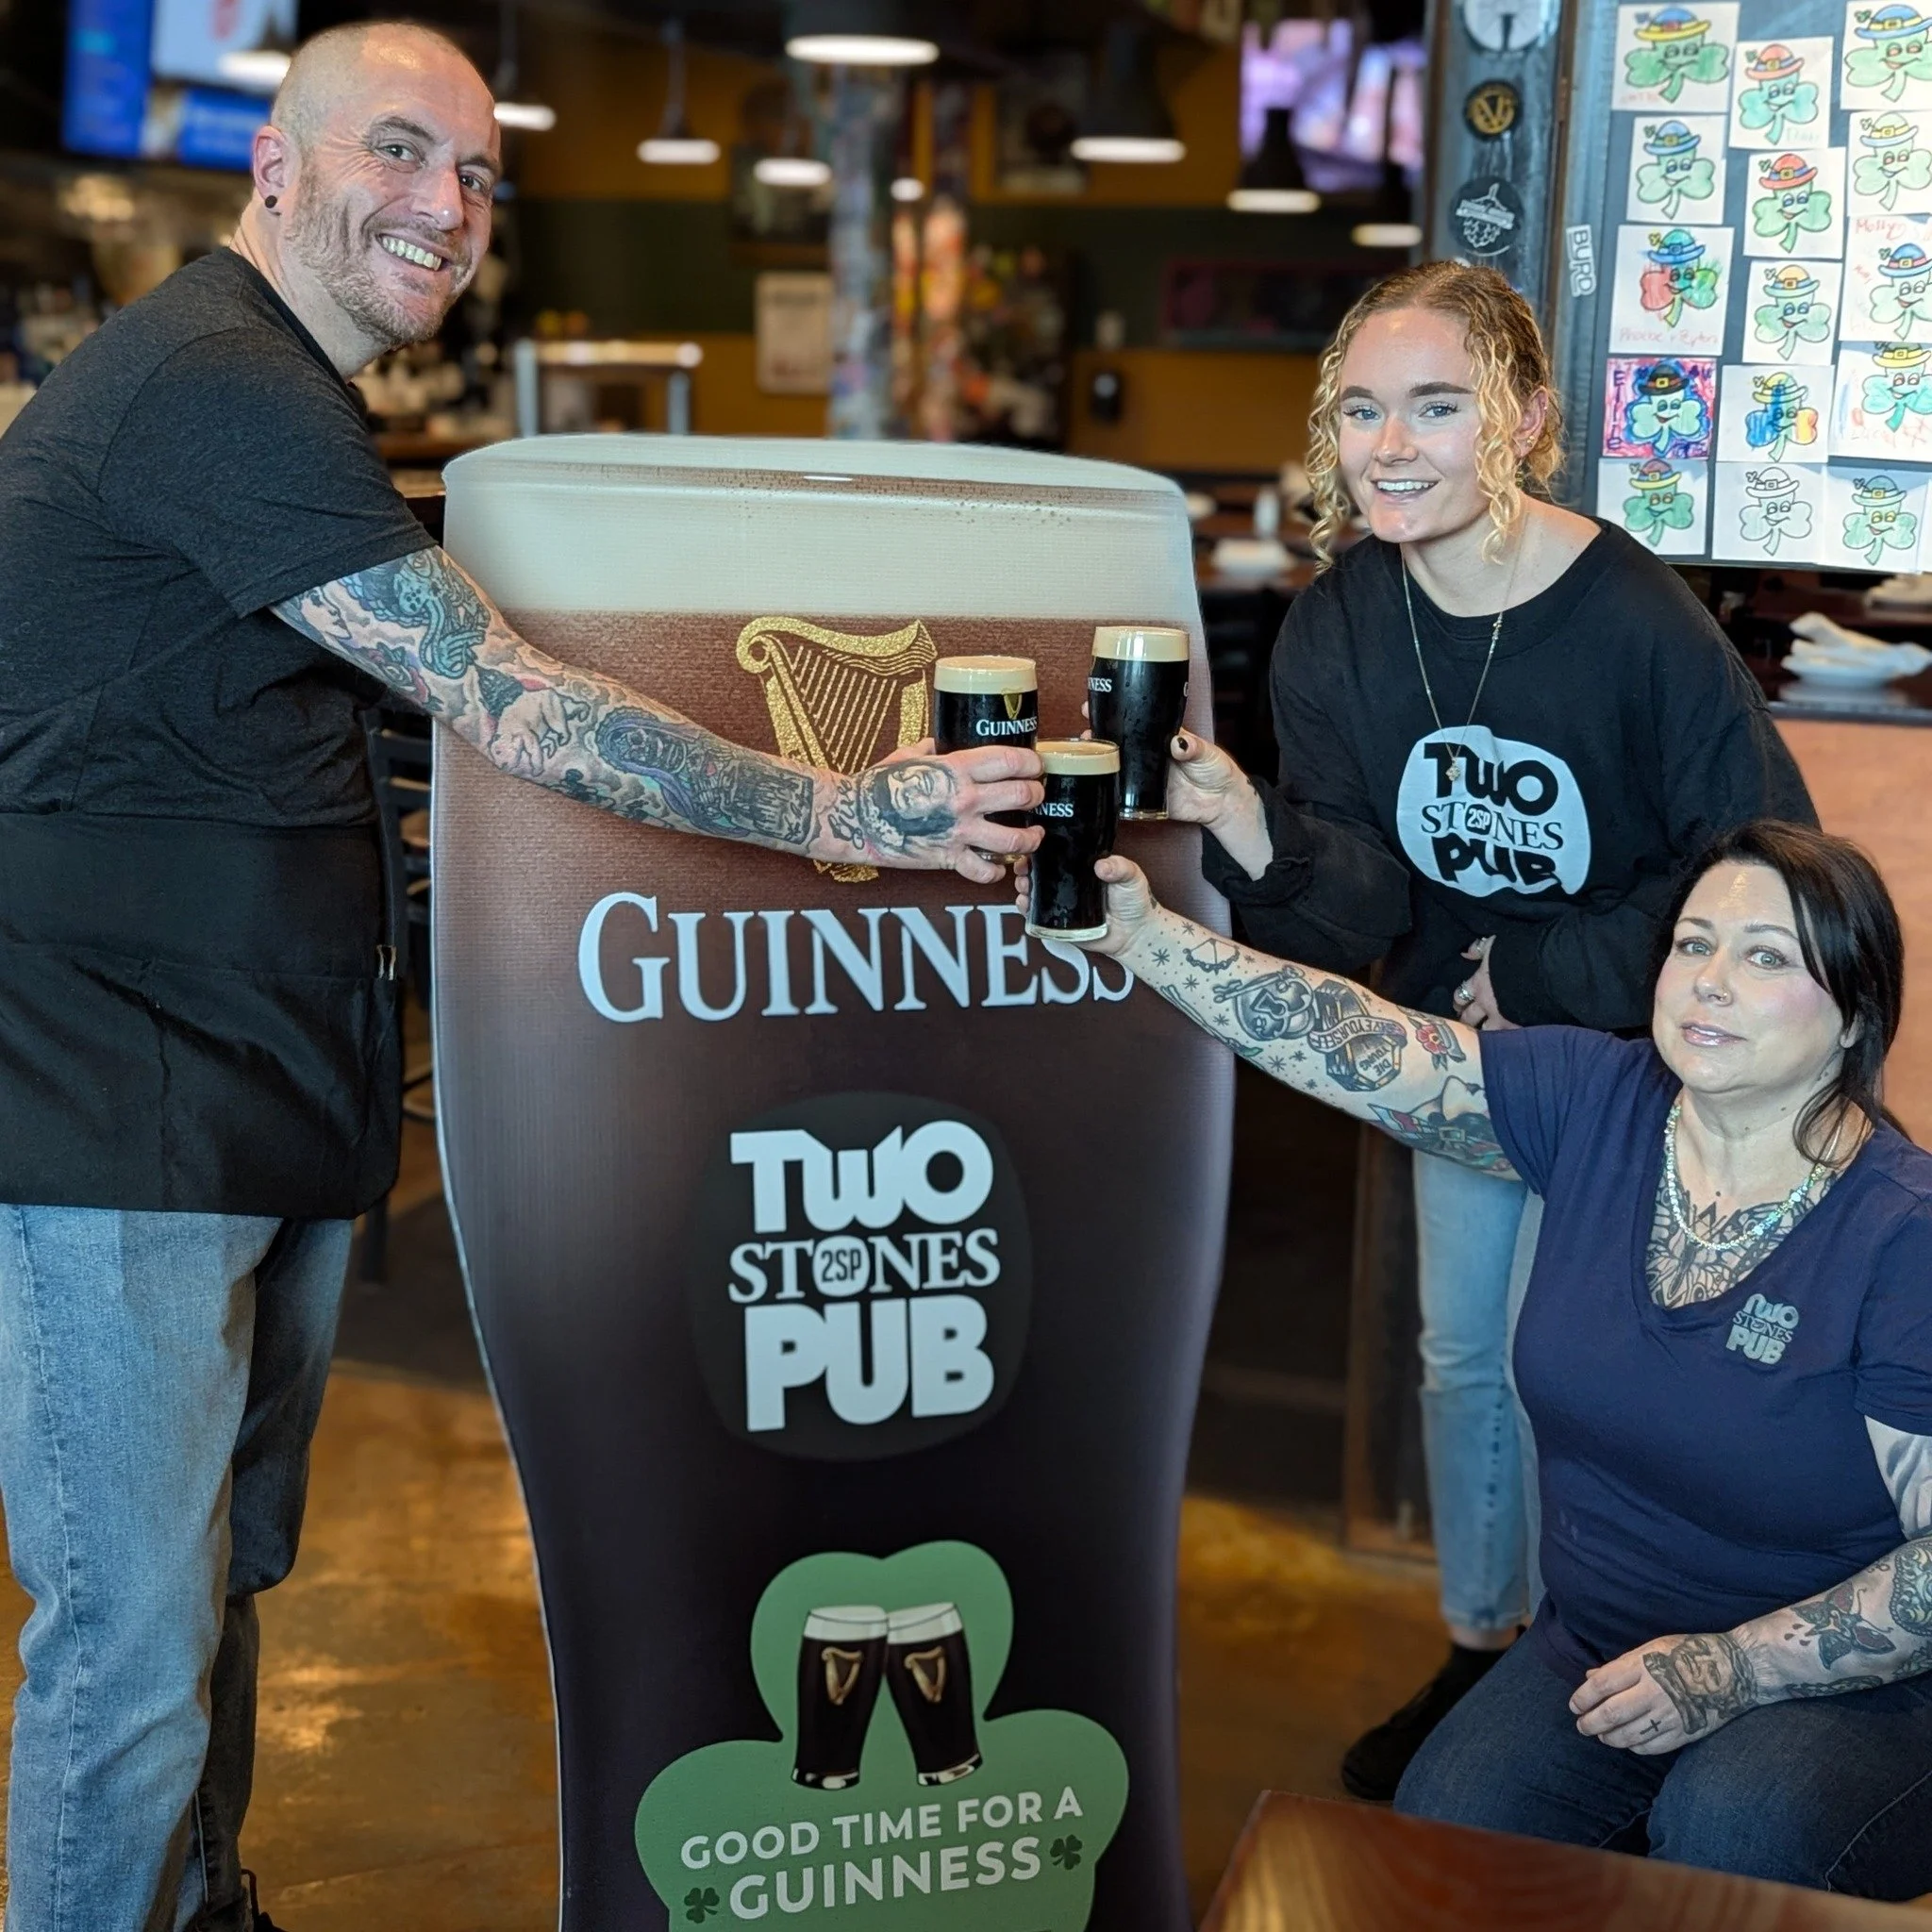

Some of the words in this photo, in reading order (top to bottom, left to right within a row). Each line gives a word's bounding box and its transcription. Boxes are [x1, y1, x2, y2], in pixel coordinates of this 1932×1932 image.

[1424, 742, 1558, 816] TWO
[1421, 802, 1564, 850] STONES
[1431, 832, 1562, 885] PUB
[730, 1120, 994, 1234] TWO
[727, 1227, 1001, 1304] STONES
[744, 1293, 995, 1432] PUB
[1725, 1324, 1786, 1365] PUB
[680, 1821, 820, 1870] GOOD
[832, 1803, 942, 1849] TIME
[958, 1790, 1043, 1833] FOR
[1054, 1786, 1084, 1821] A
[728, 1836, 1041, 1921] GUINNESS
